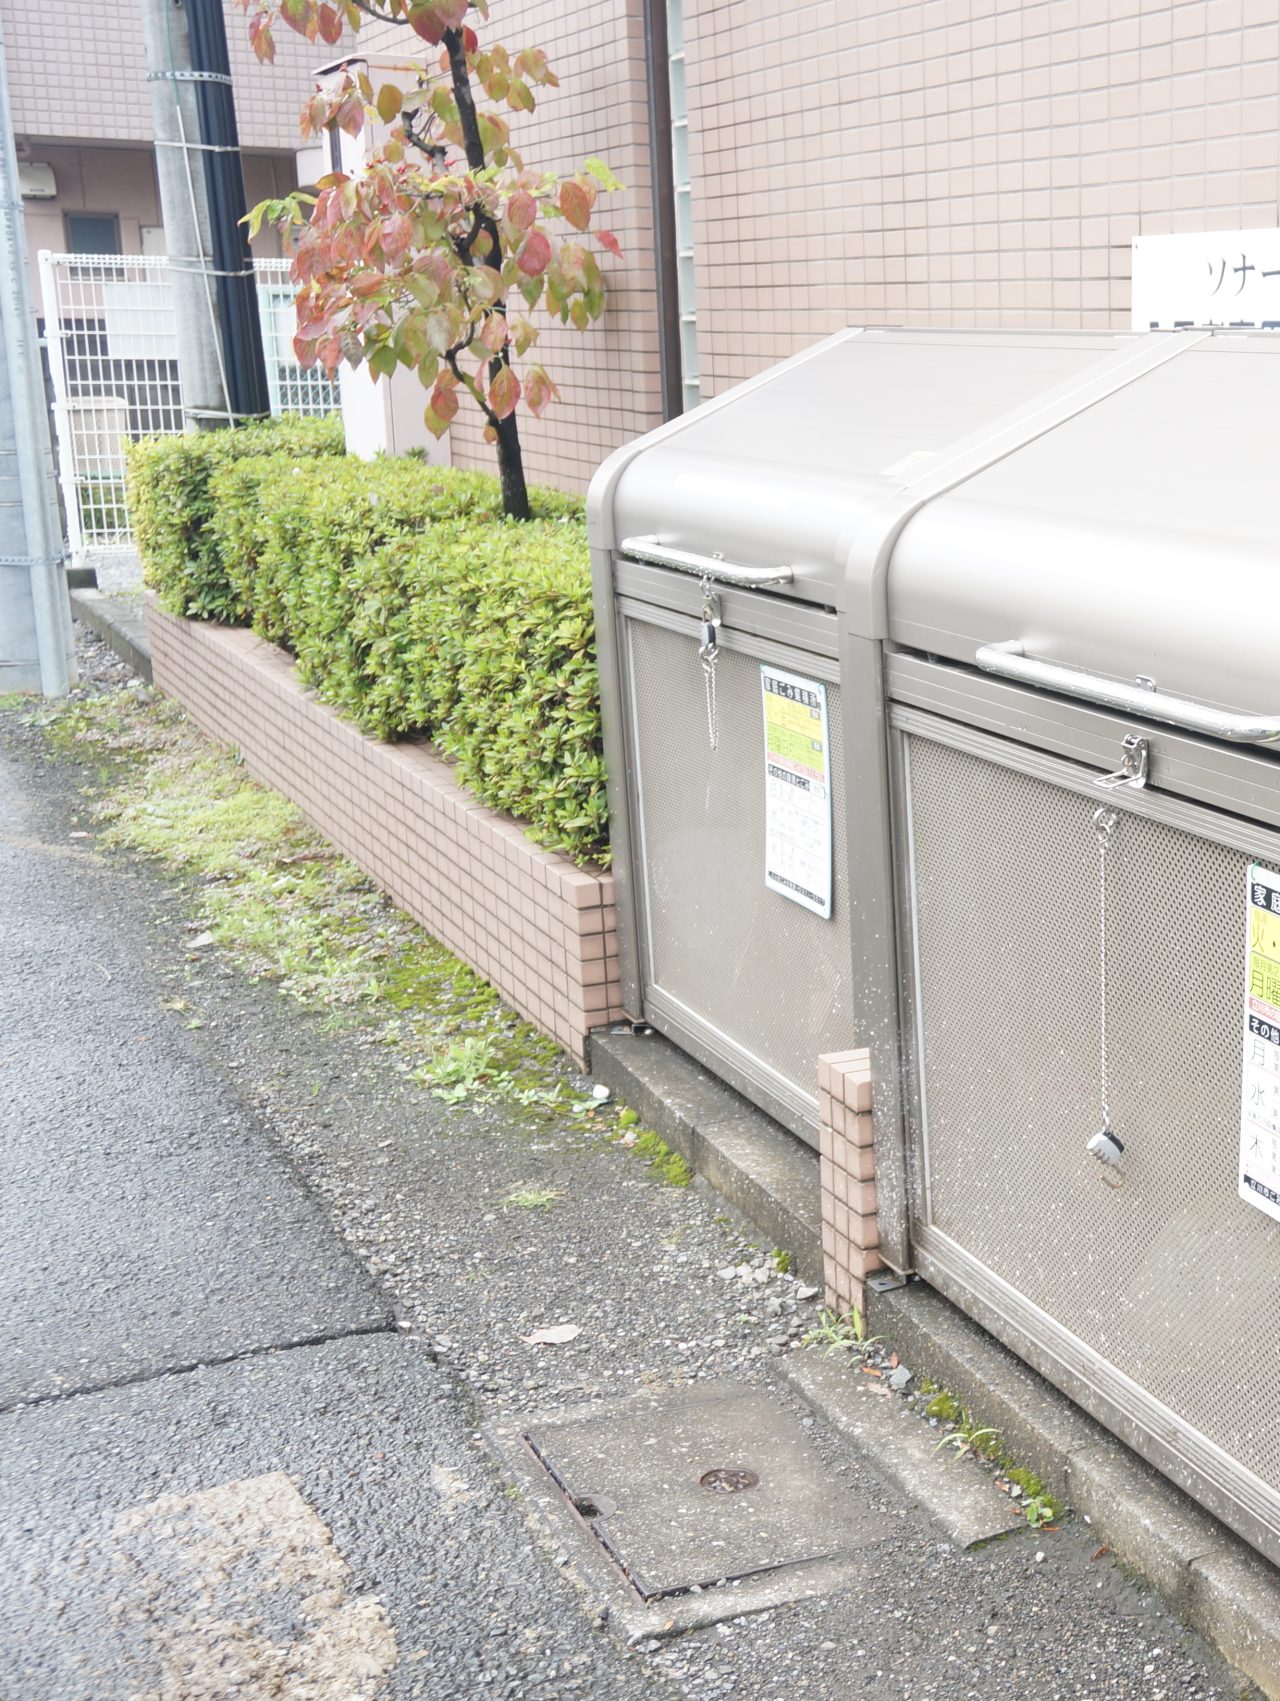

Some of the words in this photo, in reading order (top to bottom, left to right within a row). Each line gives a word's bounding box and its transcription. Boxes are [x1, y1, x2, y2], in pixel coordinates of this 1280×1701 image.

[1252, 1037, 1265, 1066] 月
[1251, 1078, 1265, 1109] 水
[1249, 1130, 1263, 1161] 木
